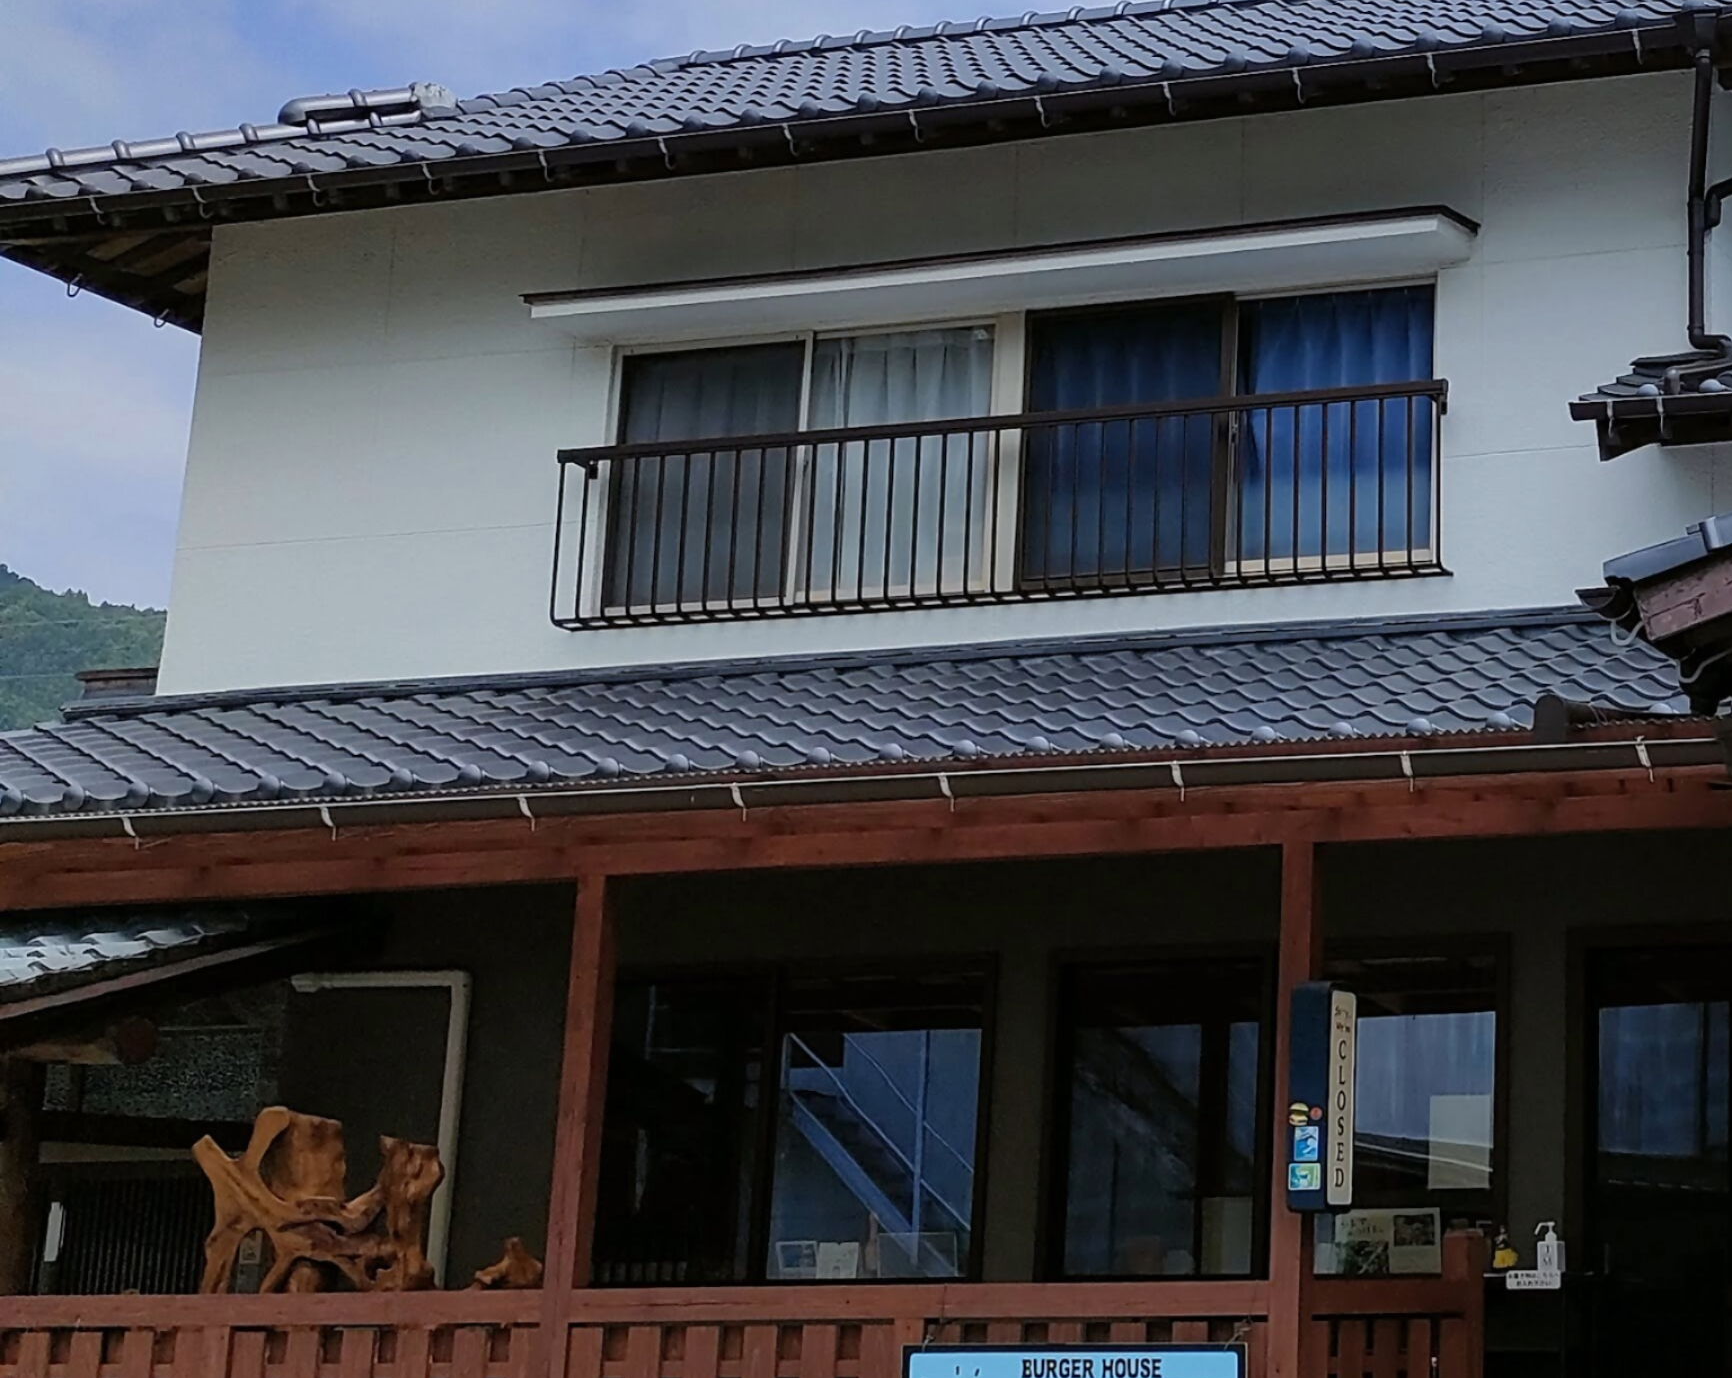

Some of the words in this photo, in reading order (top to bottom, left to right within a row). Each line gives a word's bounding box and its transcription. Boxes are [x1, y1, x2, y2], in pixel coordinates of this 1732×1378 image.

[1335, 1039, 1347, 1188] CLOSED
[1022, 1359, 1093, 1378] BURGER
[1102, 1359, 1162, 1378] HOUSE
